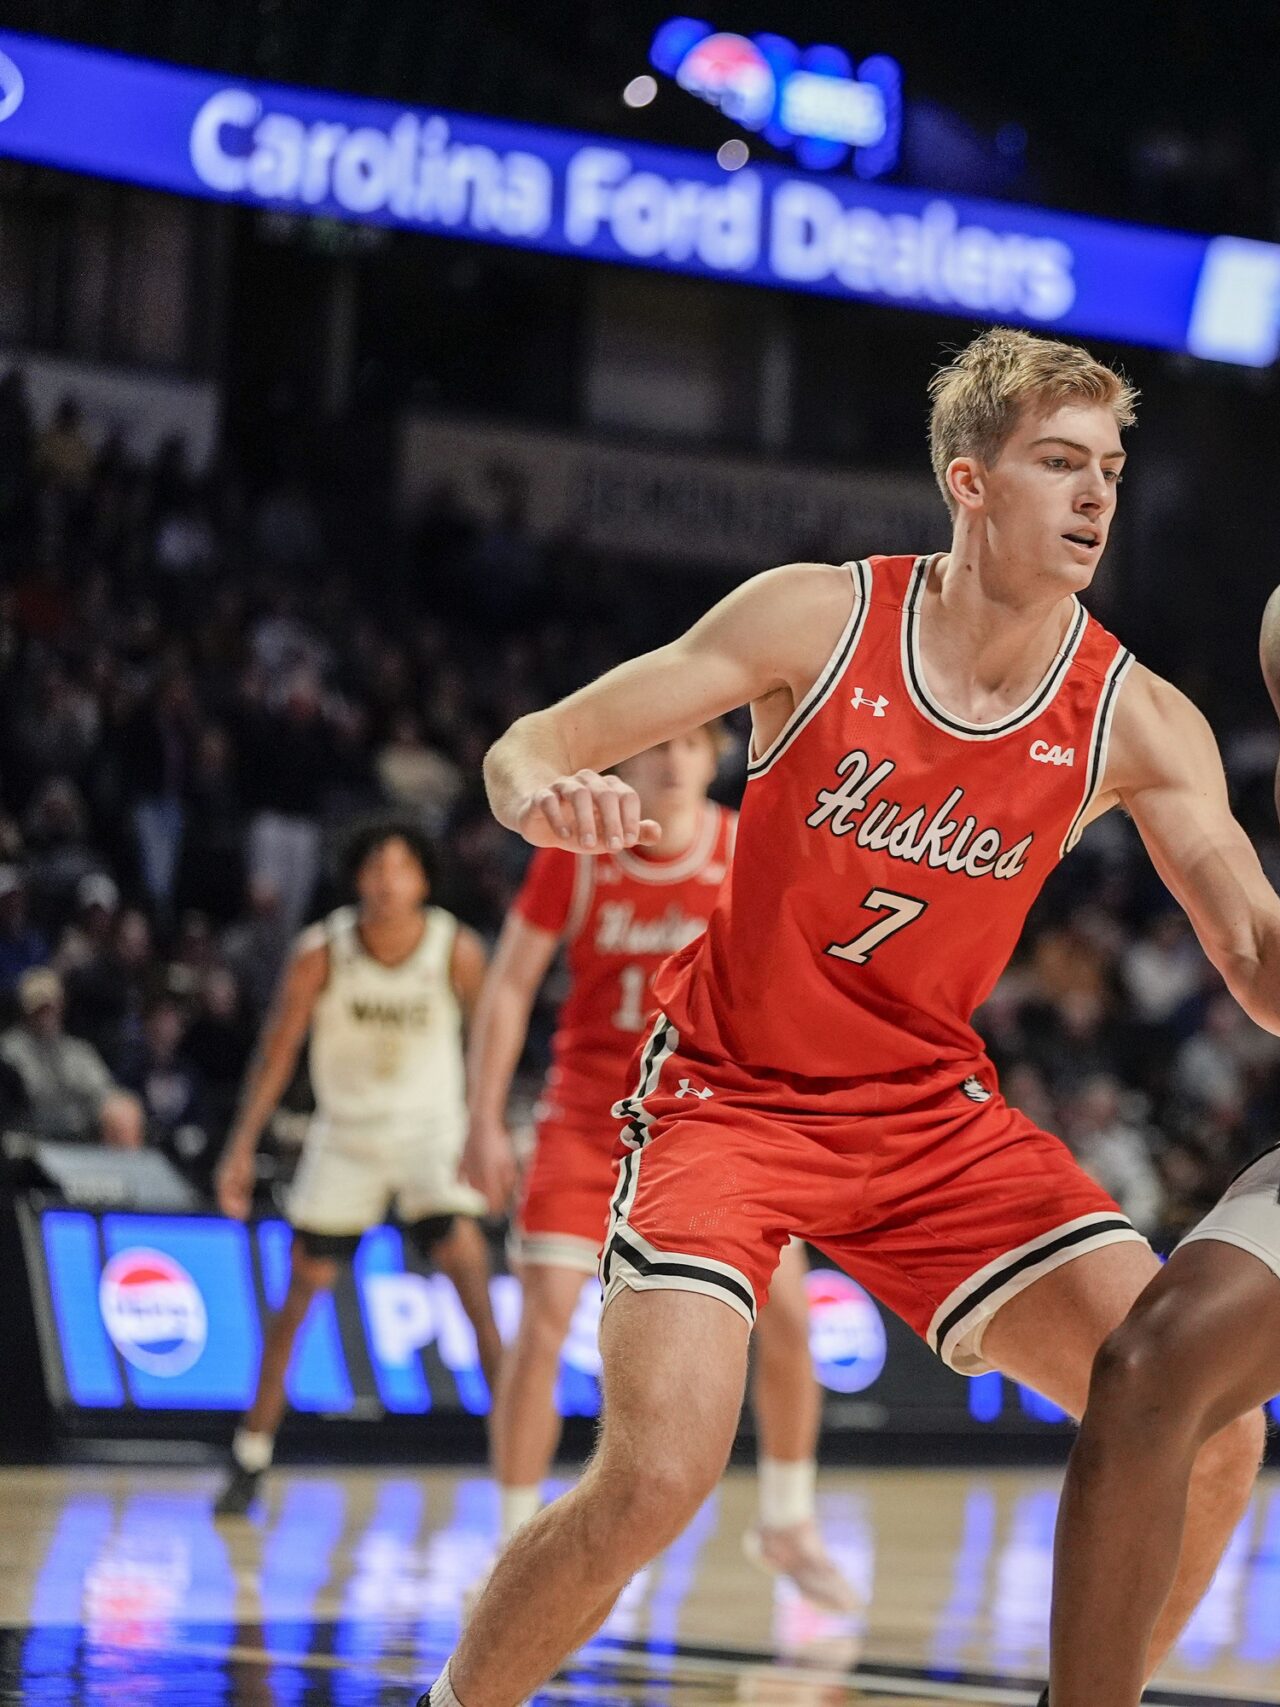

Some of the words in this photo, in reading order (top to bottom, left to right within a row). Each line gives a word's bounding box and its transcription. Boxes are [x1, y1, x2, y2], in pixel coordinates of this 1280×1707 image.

[190, 87, 555, 240] Carolina
[563, 145, 763, 272] Ford
[770, 178, 1074, 322] Dealers
[1029, 739, 1075, 767] CAA
[805, 748, 1034, 880] Huskies
[823, 886, 929, 966] 7
